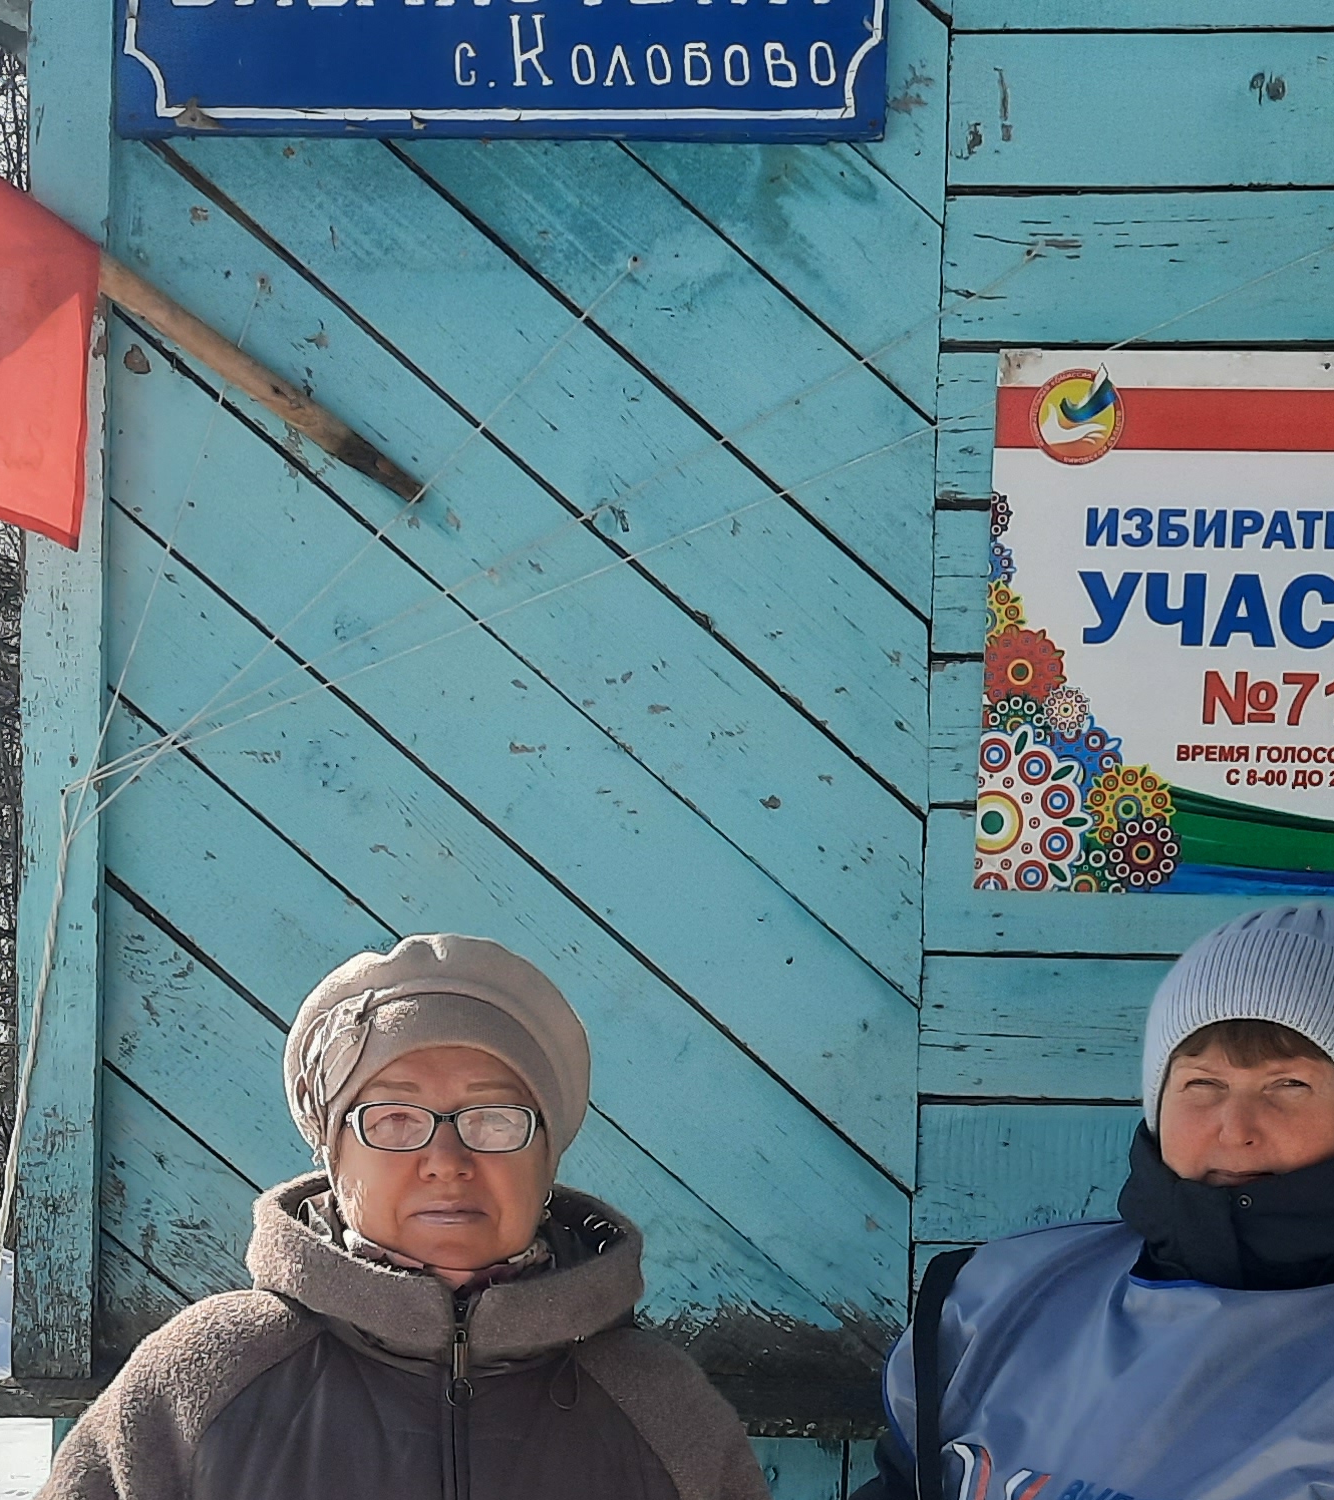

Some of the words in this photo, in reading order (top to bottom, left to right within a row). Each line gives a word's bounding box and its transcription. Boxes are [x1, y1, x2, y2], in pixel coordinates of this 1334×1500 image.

[509, 14, 837, 86] Колобово
[1175, 744, 1250, 762] ВРЕМЯ
[1225, 768, 1241, 786] С
[1246, 768, 1288, 787] 8-00
[1291, 769, 1324, 789] ДО
